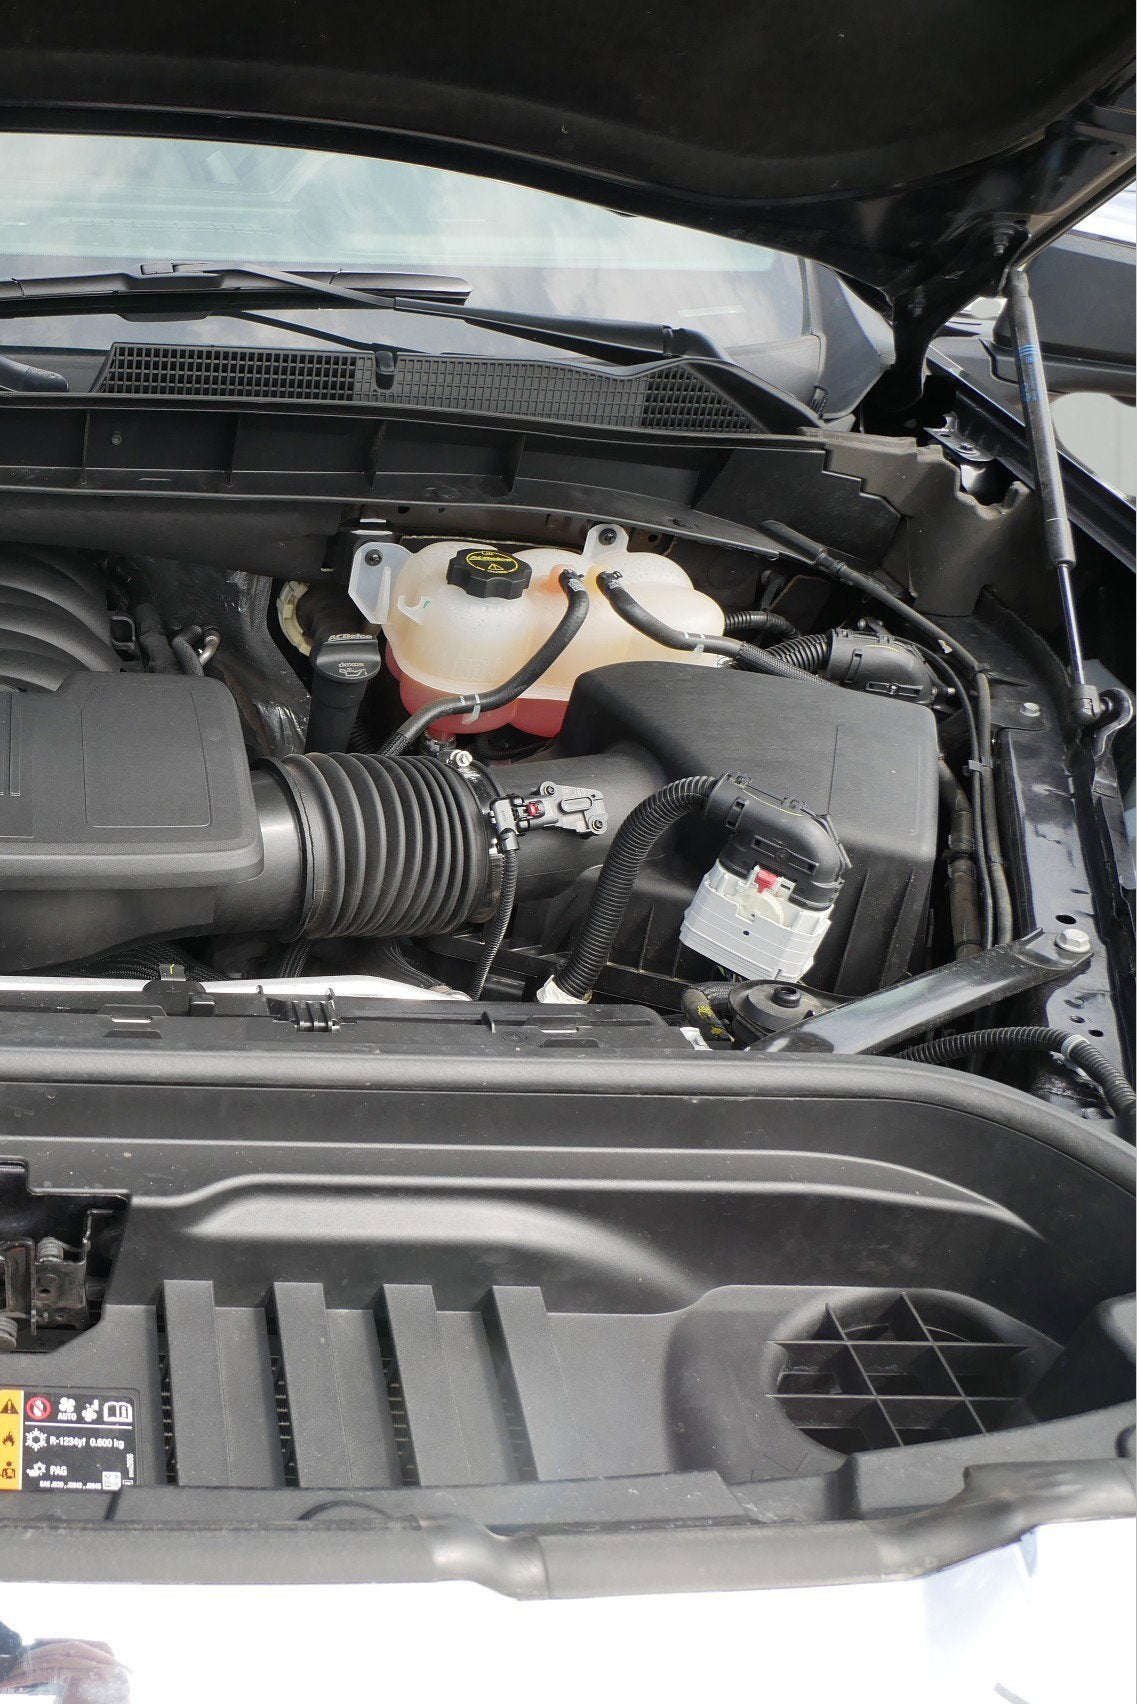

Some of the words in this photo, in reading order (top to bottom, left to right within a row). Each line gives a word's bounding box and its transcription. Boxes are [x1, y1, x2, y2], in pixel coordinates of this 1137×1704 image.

[328, 633, 373, 642] ACDelco
[57, 1412, 77, 1421] AUTO
[49, 1435, 87, 1448] R-1234yf
[114, 1438, 125, 1450] kg
[49, 1465, 68, 1476] PAG
